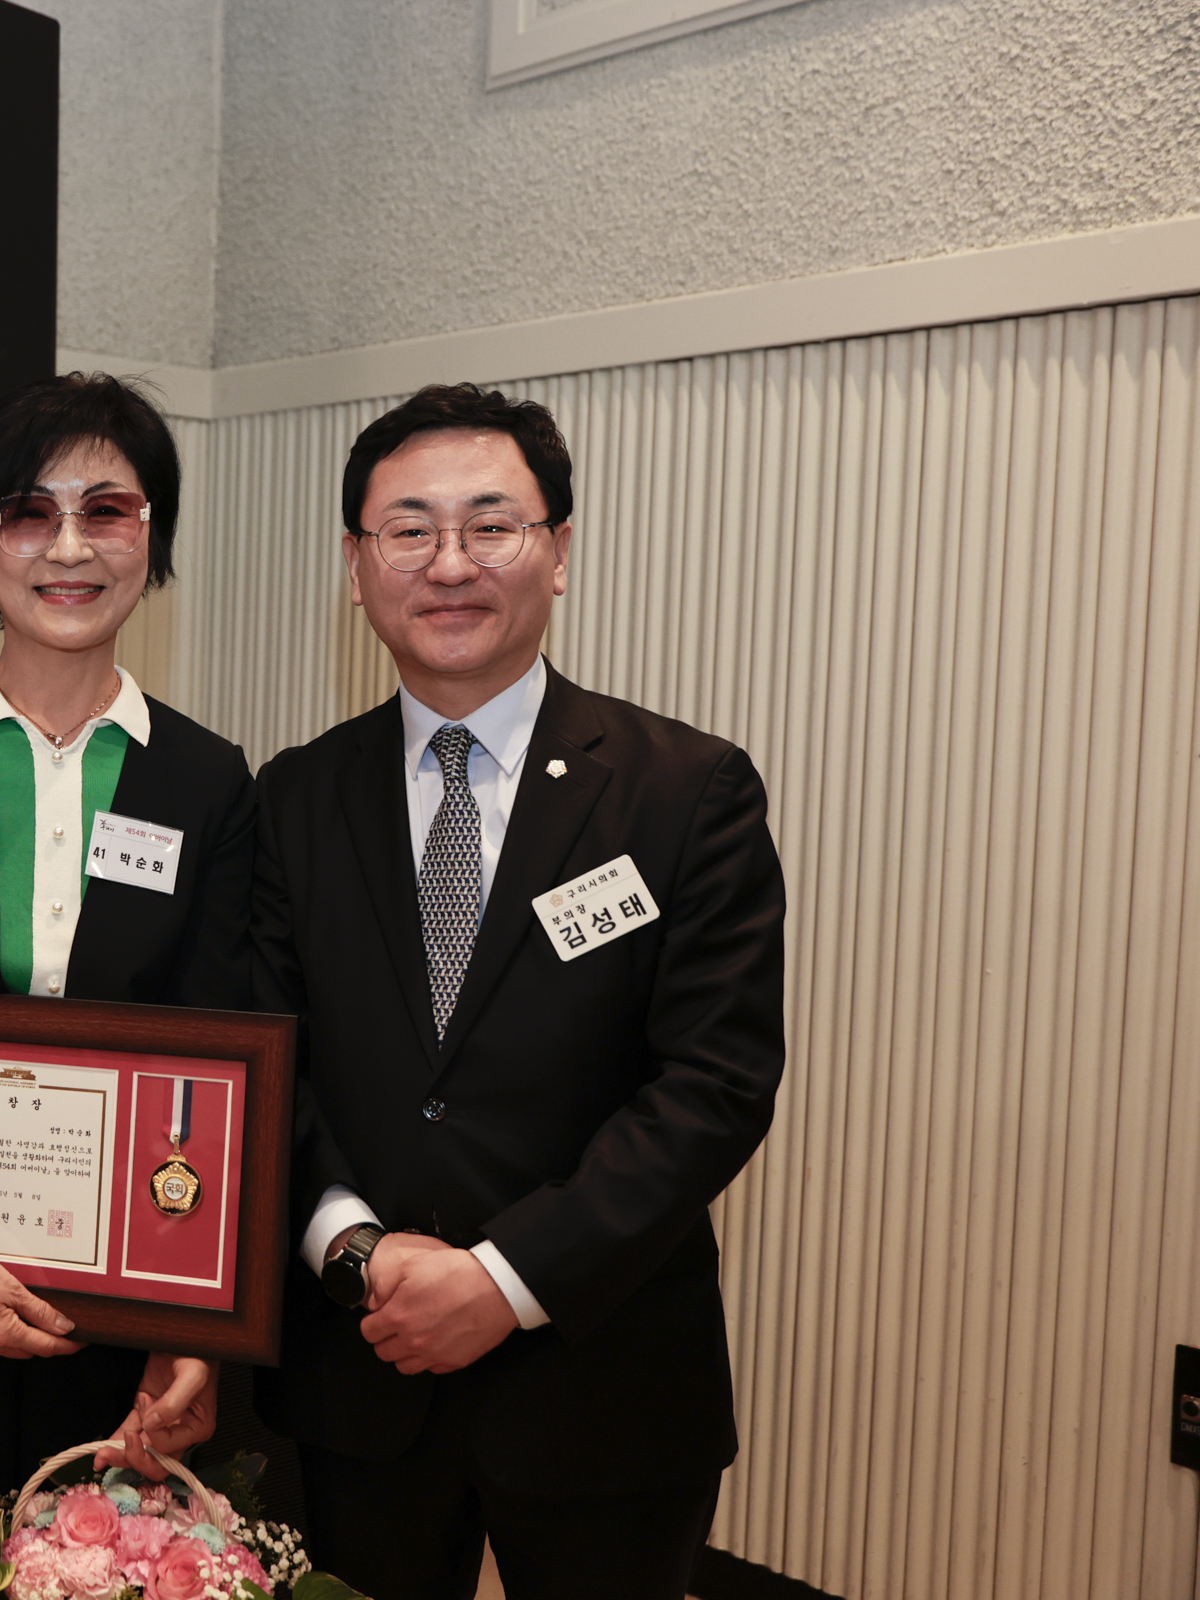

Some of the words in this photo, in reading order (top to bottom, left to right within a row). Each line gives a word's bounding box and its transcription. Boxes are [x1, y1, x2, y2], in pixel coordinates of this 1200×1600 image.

[125, 827, 146, 838] 제54회
[93, 847, 106, 859] 41
[120, 852, 163, 874] 박순화
[567, 868, 618, 898] 구리시의회
[552, 904, 586, 925] 부의장
[559, 892, 647, 949] 김성태
[17, 1140, 44, 1150] 사명감과
[58, 1156, 91, 1166] 구리시민의
[64, 1169, 90, 1178] 맞이하여
[166, 1182, 183, 1194] 국회
[17, 1214, 64, 1229] 윤호중
